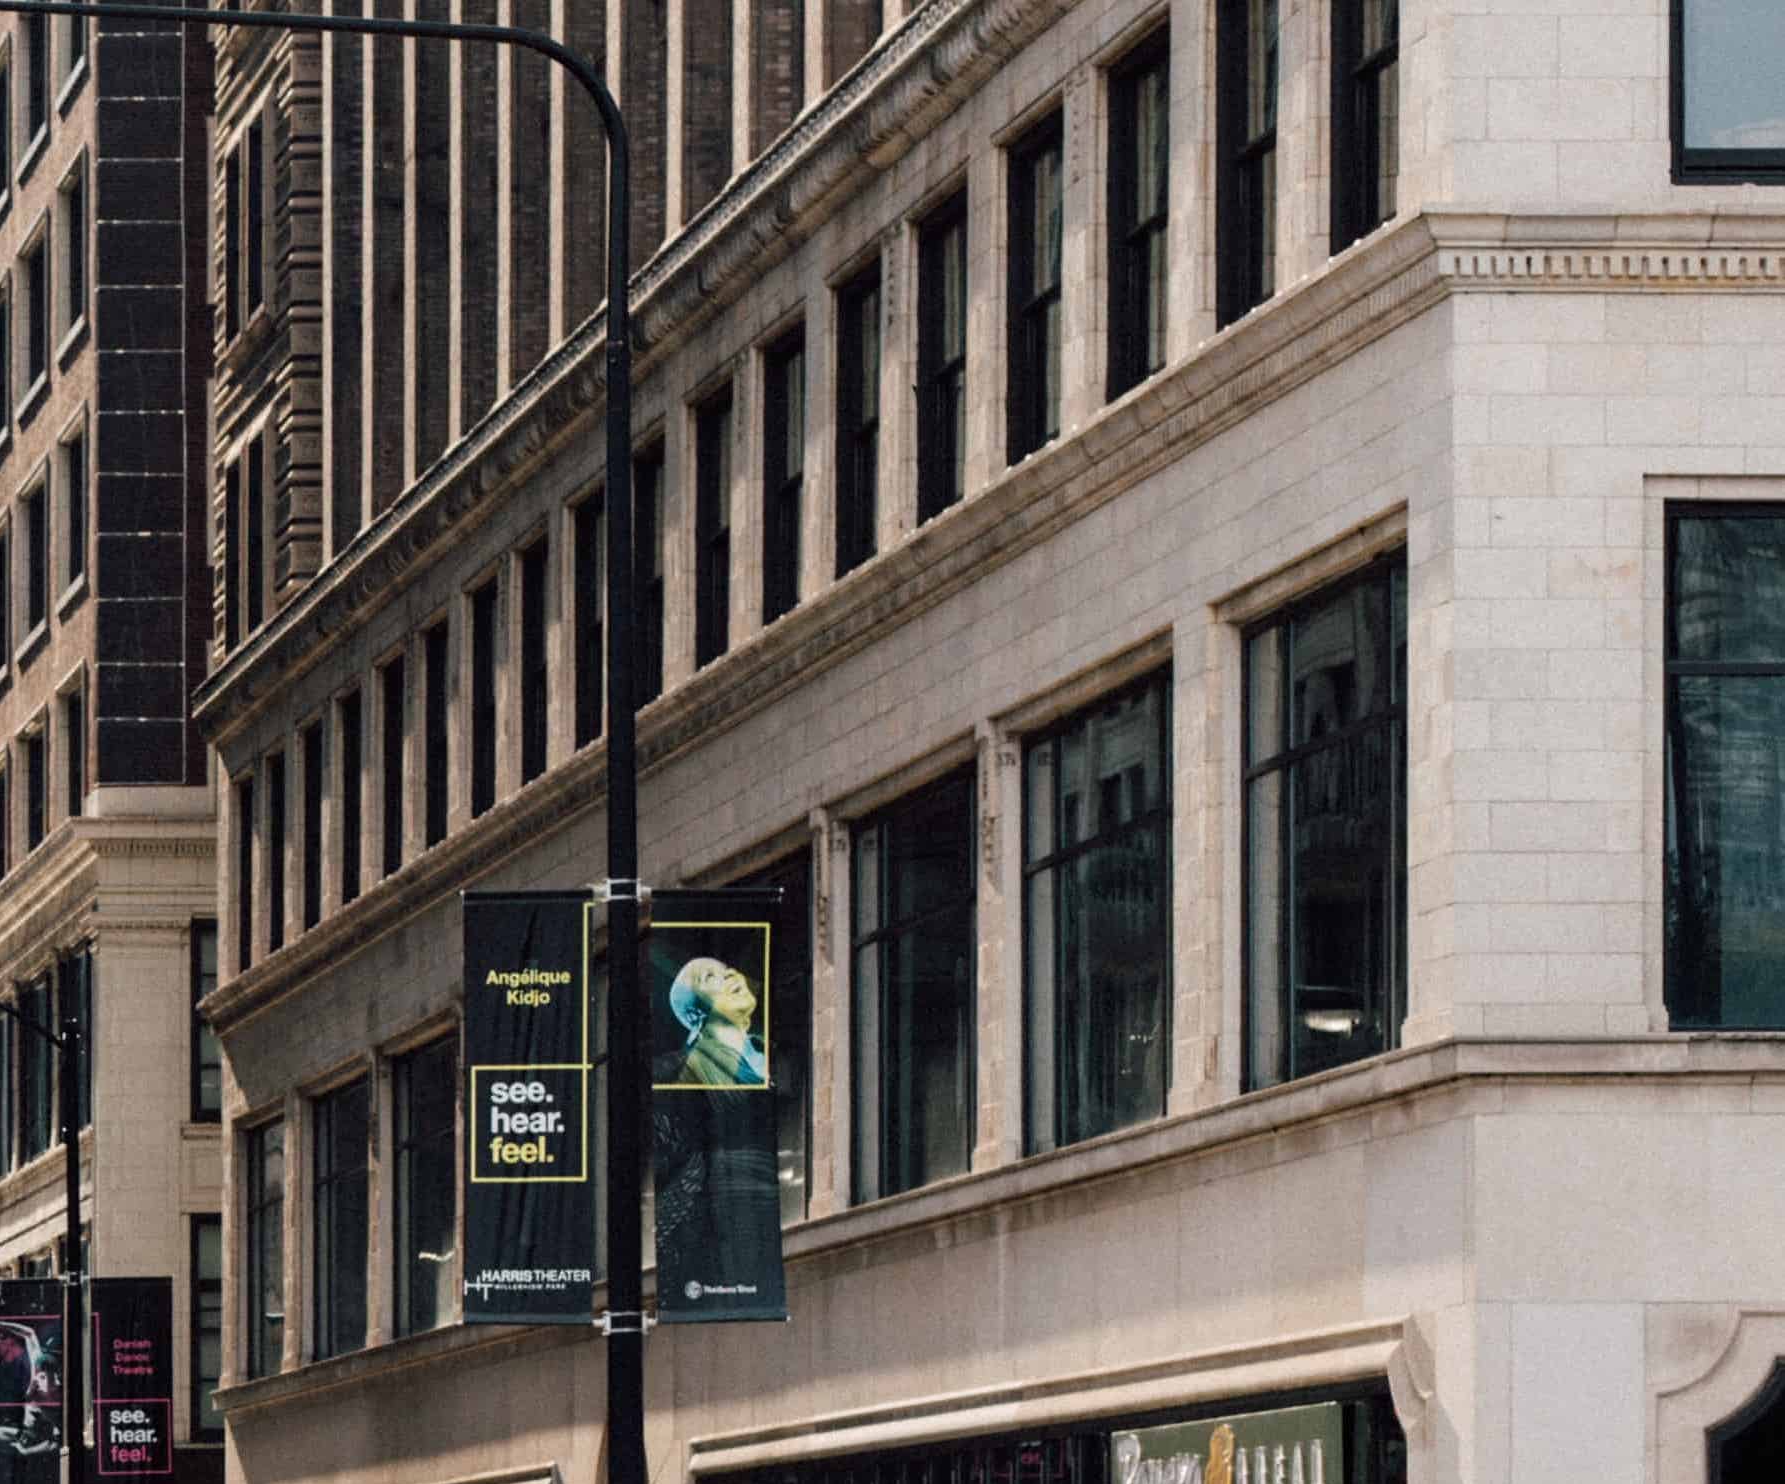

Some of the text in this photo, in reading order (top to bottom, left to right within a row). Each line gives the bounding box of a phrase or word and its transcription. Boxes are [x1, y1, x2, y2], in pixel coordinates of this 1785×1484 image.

[486, 969, 571, 987] Angélique
[506, 990, 551, 1007] Kidjo
[491, 1081, 554, 1103] see.
[491, 1106, 565, 1133] hear.
[490, 1136, 555, 1163] feel.
[482, 1270, 591, 1282] HARRIS THEATER
[110, 1409, 150, 1424] see.
[110, 1426, 158, 1444] hear.
[110, 1446, 151, 1462] feel.
